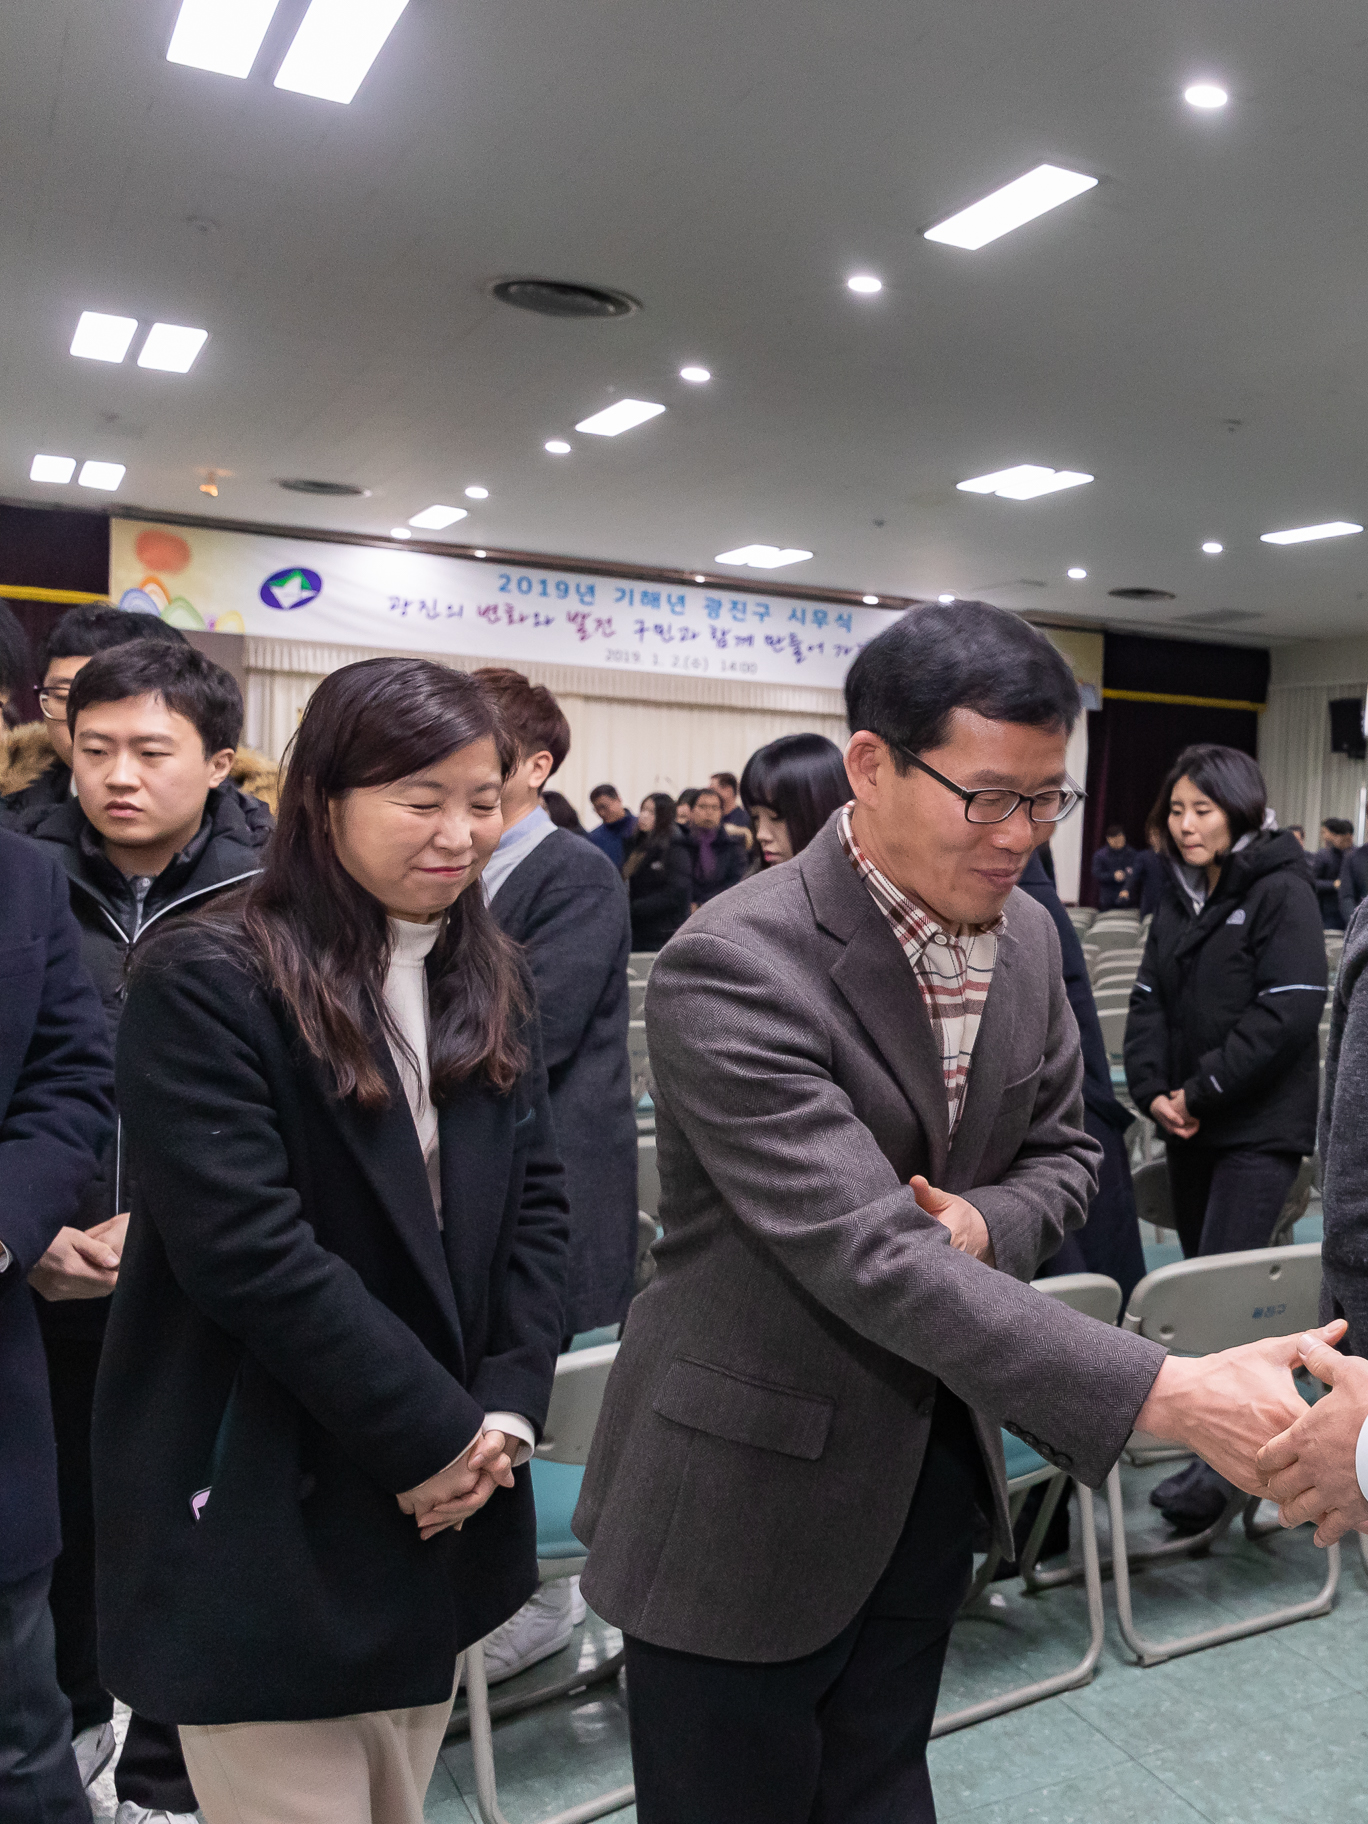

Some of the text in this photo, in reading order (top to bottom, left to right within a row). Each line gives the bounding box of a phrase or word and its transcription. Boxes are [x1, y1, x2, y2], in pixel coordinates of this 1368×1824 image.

[388, 596, 464, 621] 광진의
[477, 602, 554, 628] 변화와
[566, 610, 616, 642] 발전
[634, 618, 699, 643] 구민과
[709, 623, 755, 649] 함께
[764, 632, 824, 664] 만들어
[499, 573, 852, 633] 2019년 기해년 광진구 시무식
